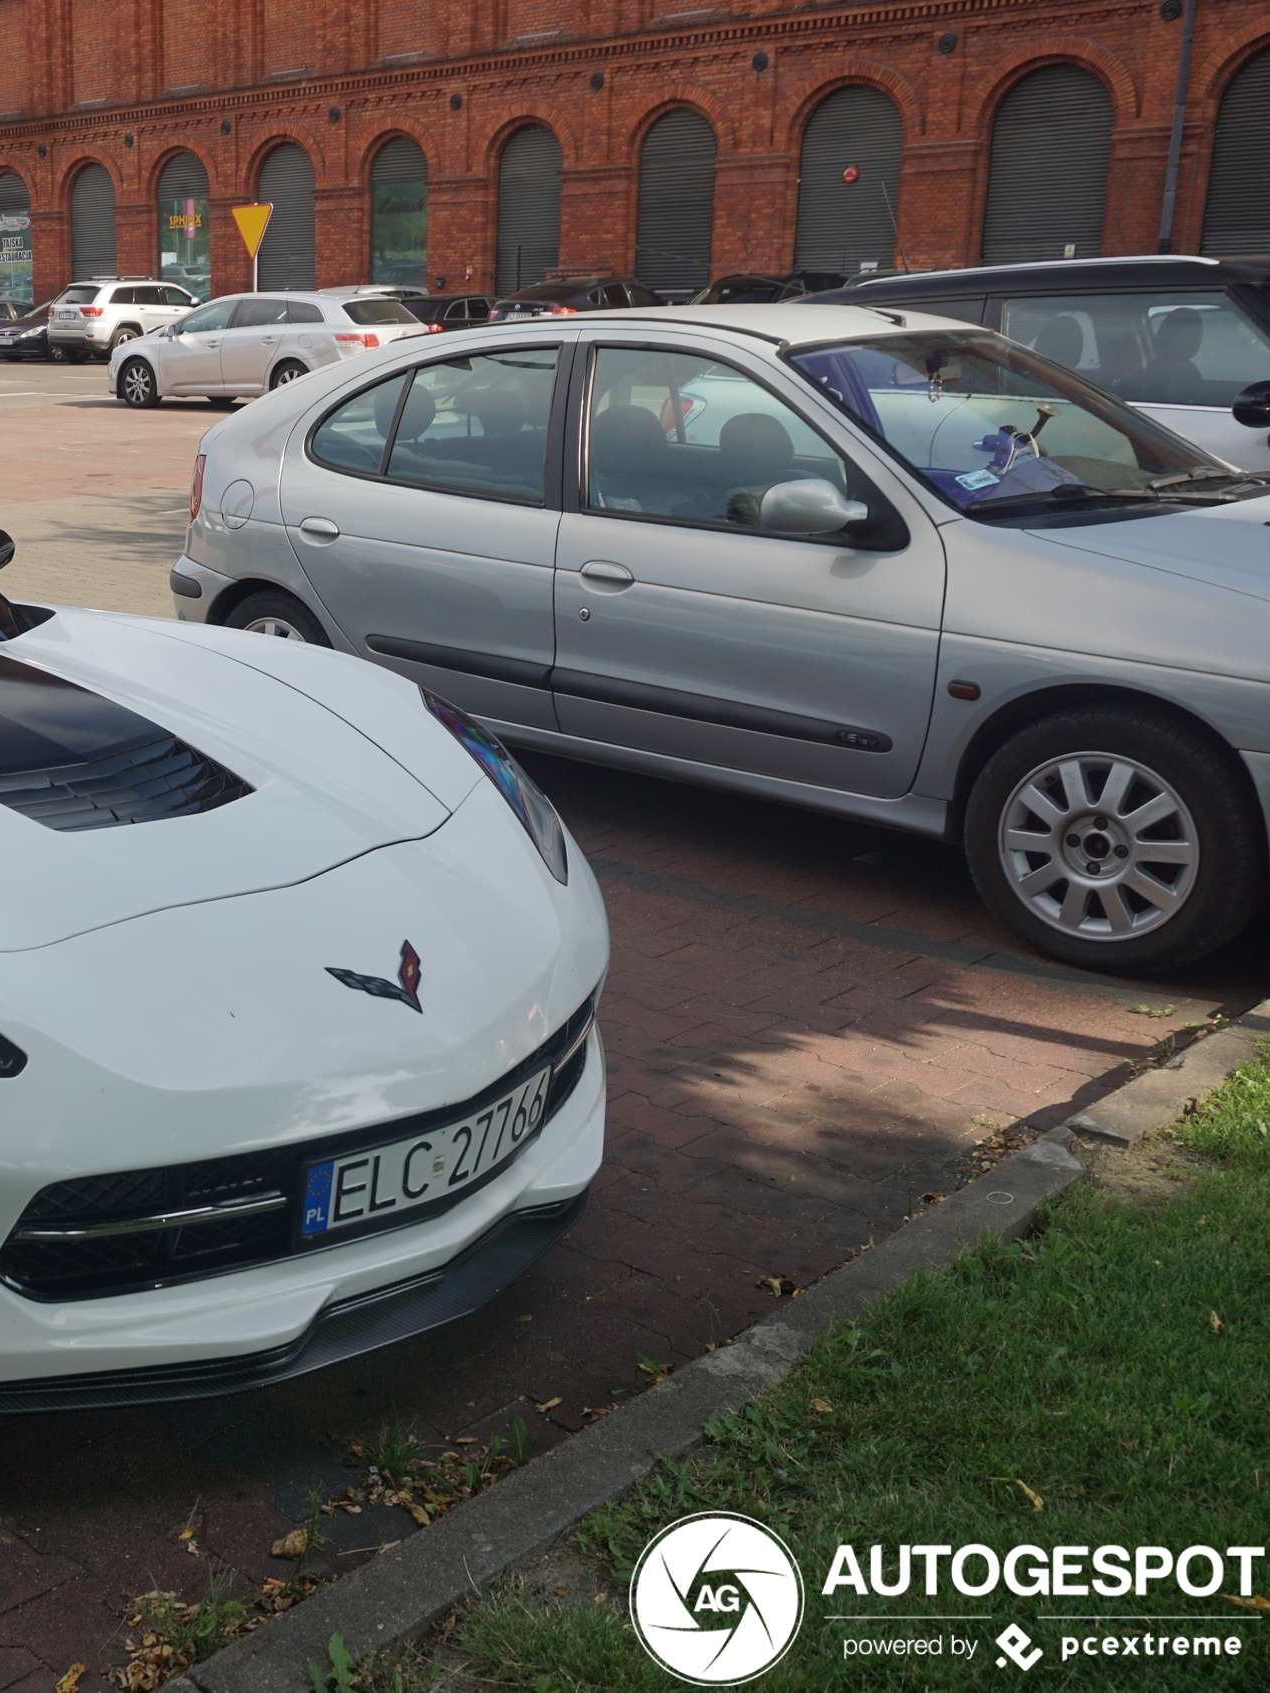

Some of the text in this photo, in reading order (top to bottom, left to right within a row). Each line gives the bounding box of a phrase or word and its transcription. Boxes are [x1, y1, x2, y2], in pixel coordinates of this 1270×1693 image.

[169, 214, 202, 226] SPHINX
[2, 237, 23, 249] TAJSKA
[305, 1072, 547, 1225] PL ELC 27766
